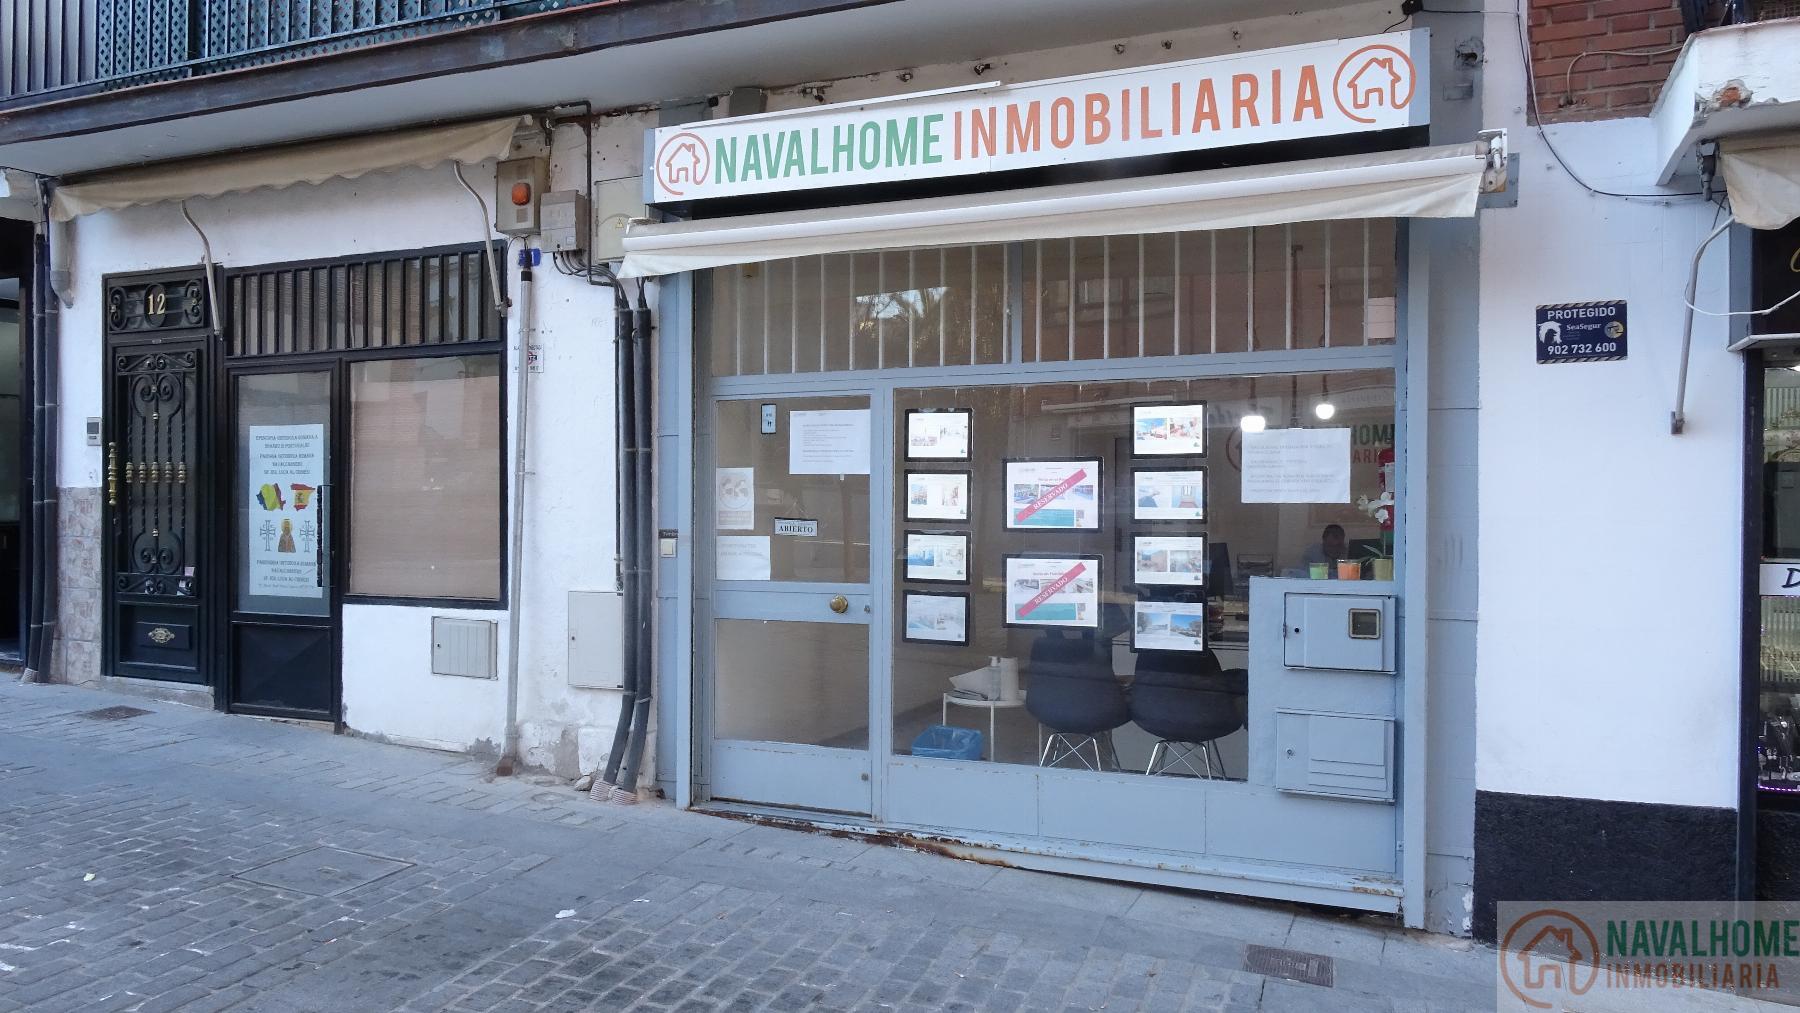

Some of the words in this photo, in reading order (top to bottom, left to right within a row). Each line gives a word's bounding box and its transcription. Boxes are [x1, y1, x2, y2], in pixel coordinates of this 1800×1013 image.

[714, 114, 944, 185] NAVALHOME
[953, 64, 1325, 161] INMOBILIARIA
[148, 293, 166, 315] 12
[1547, 307, 1615, 320] PROTEGIDO
[1547, 345, 1568, 355] 902
[1571, 344, 1592, 354] 732
[1595, 342, 1616, 352] 600
[1033, 482, 1069, 510] RESERVADO
[778, 525, 814, 534] ABIERTO
[1034, 577, 1069, 605] RESERVADO
